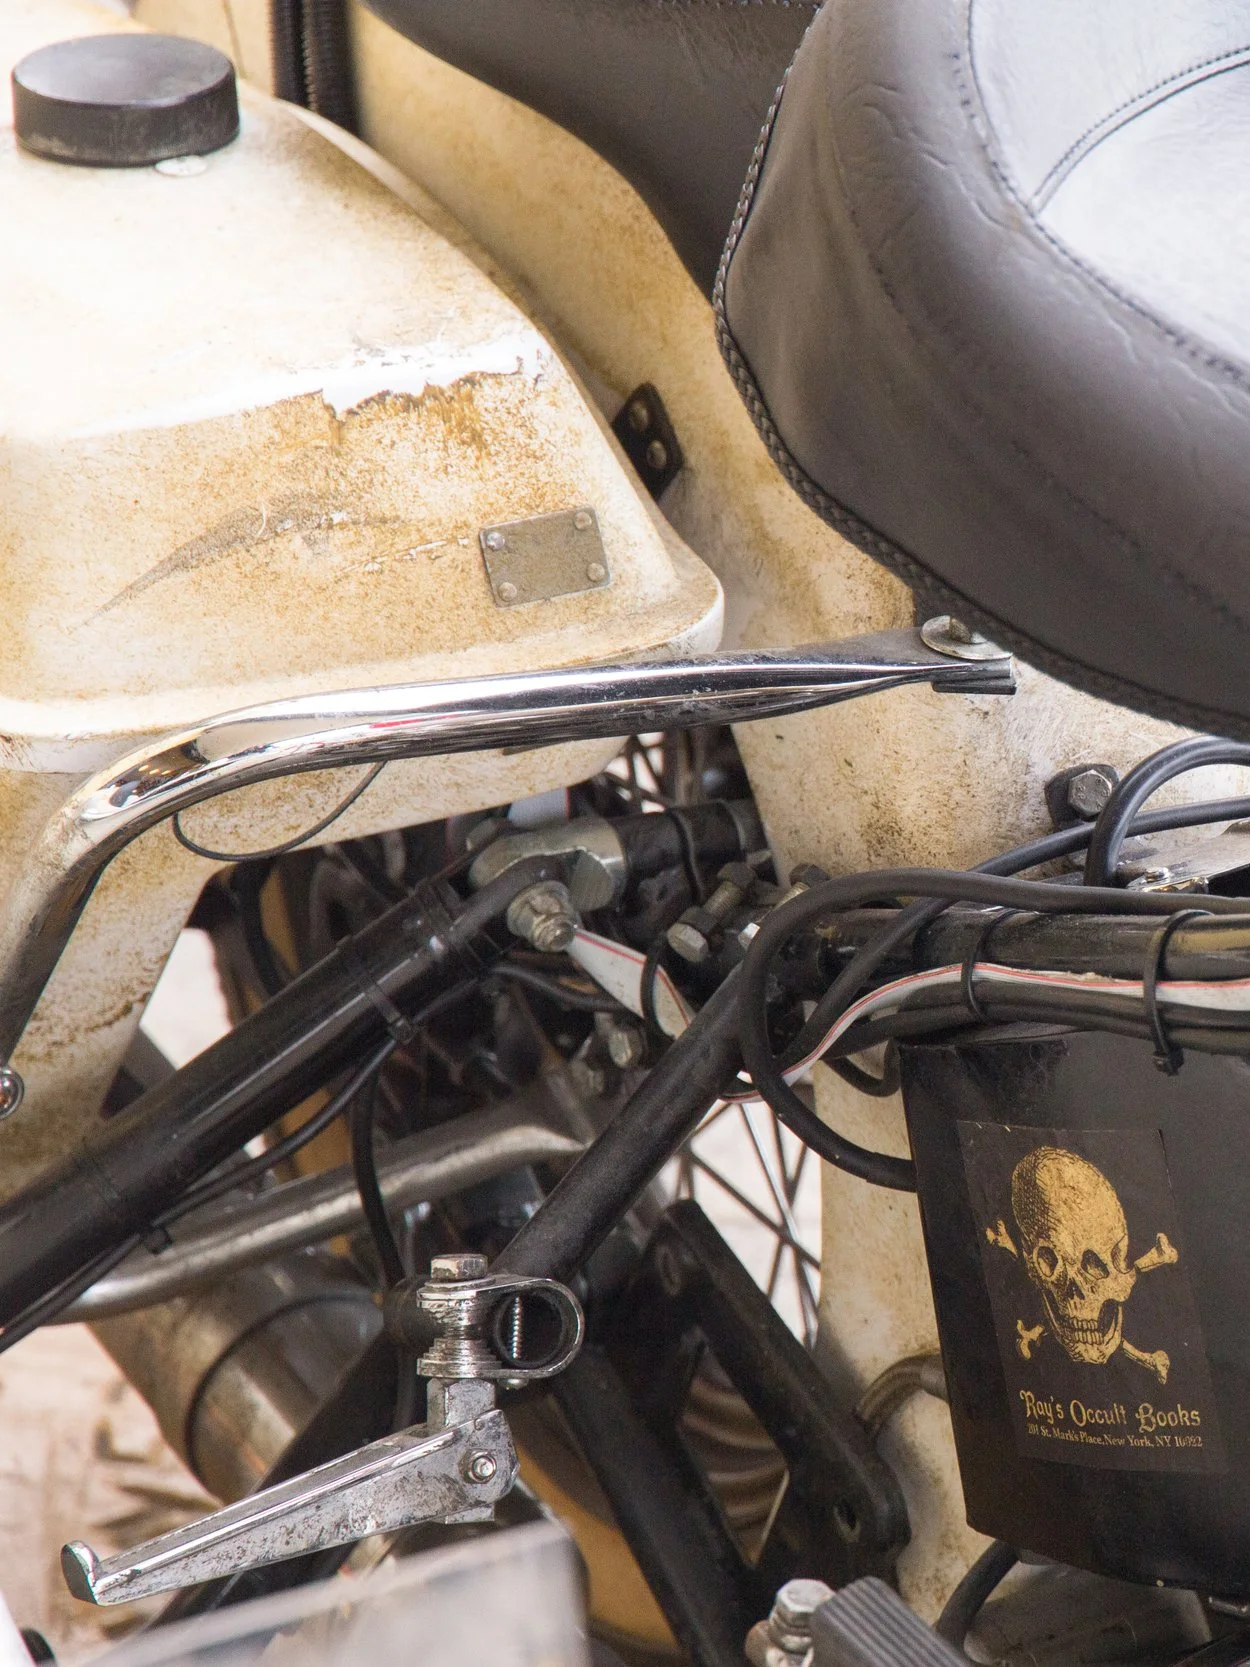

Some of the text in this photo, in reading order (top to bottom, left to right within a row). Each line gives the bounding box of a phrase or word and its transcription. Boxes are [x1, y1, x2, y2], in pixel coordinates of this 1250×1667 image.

[1020, 1390, 1200, 1433] Ray's Occult Books
[1052, 1427, 1079, 1442] Mark's
[1104, 1434, 1125, 1446] New
[1155, 1435, 1171, 1447] NY
